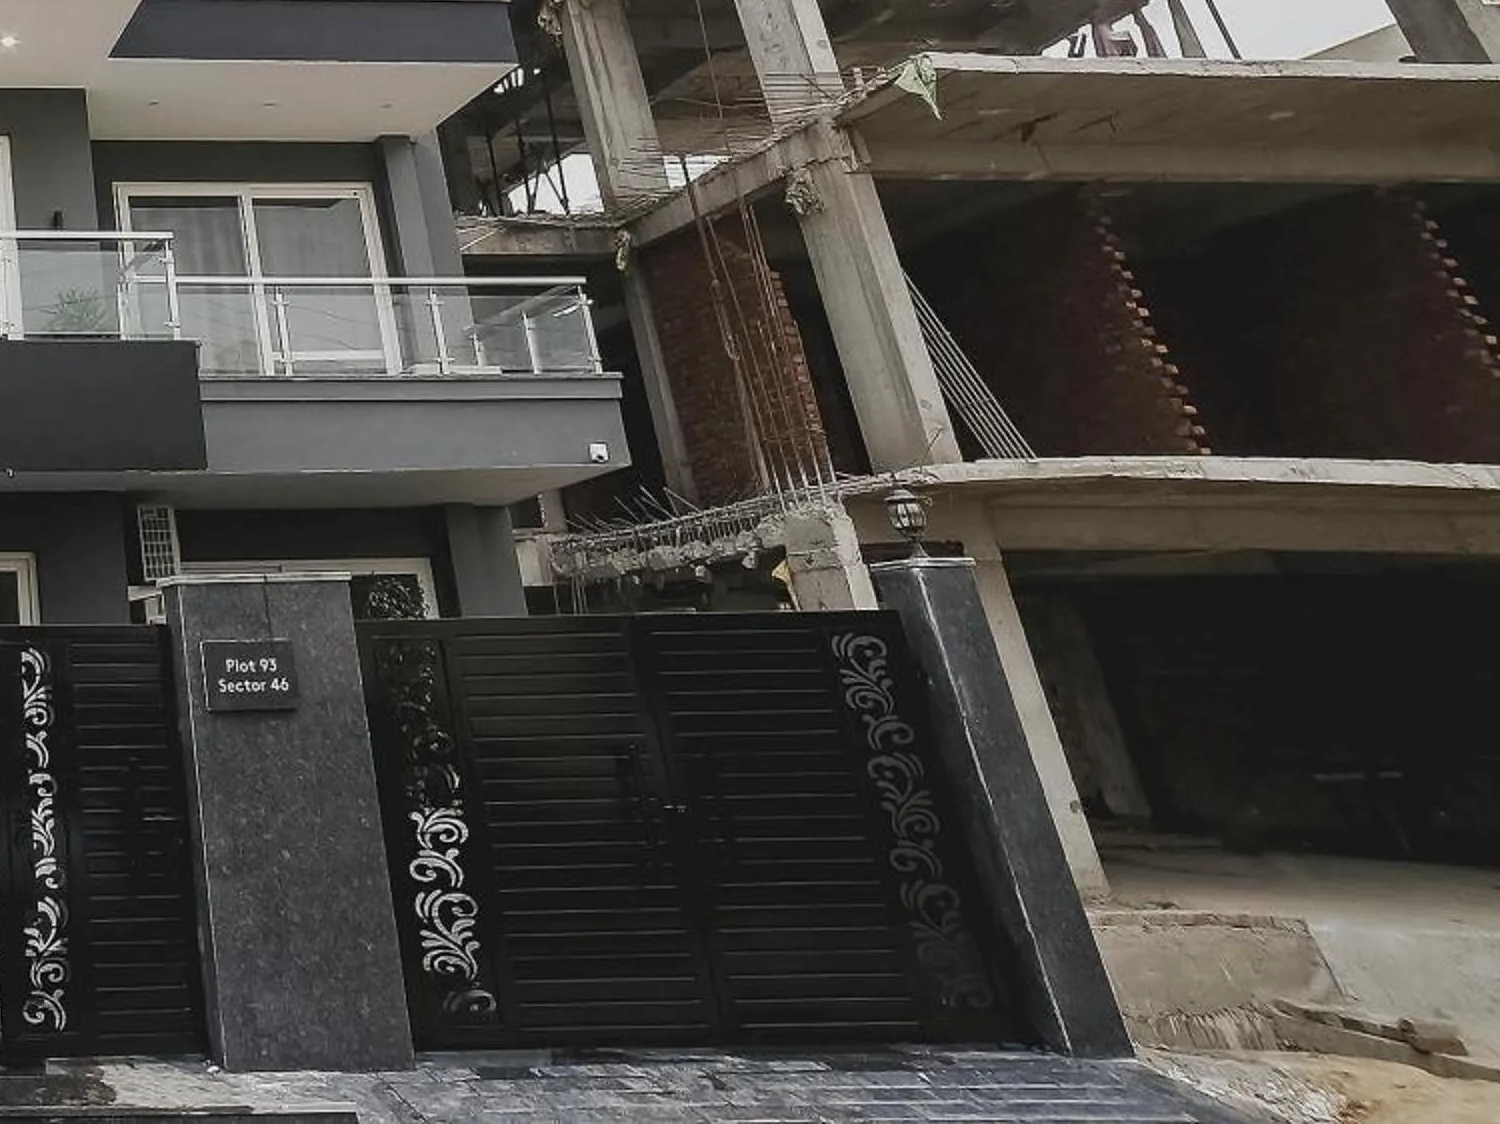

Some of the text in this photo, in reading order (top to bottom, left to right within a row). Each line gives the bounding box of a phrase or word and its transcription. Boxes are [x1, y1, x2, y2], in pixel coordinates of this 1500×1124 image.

[225, 657, 278, 673] Plot 93
[218, 677, 290, 693] Sector 46
